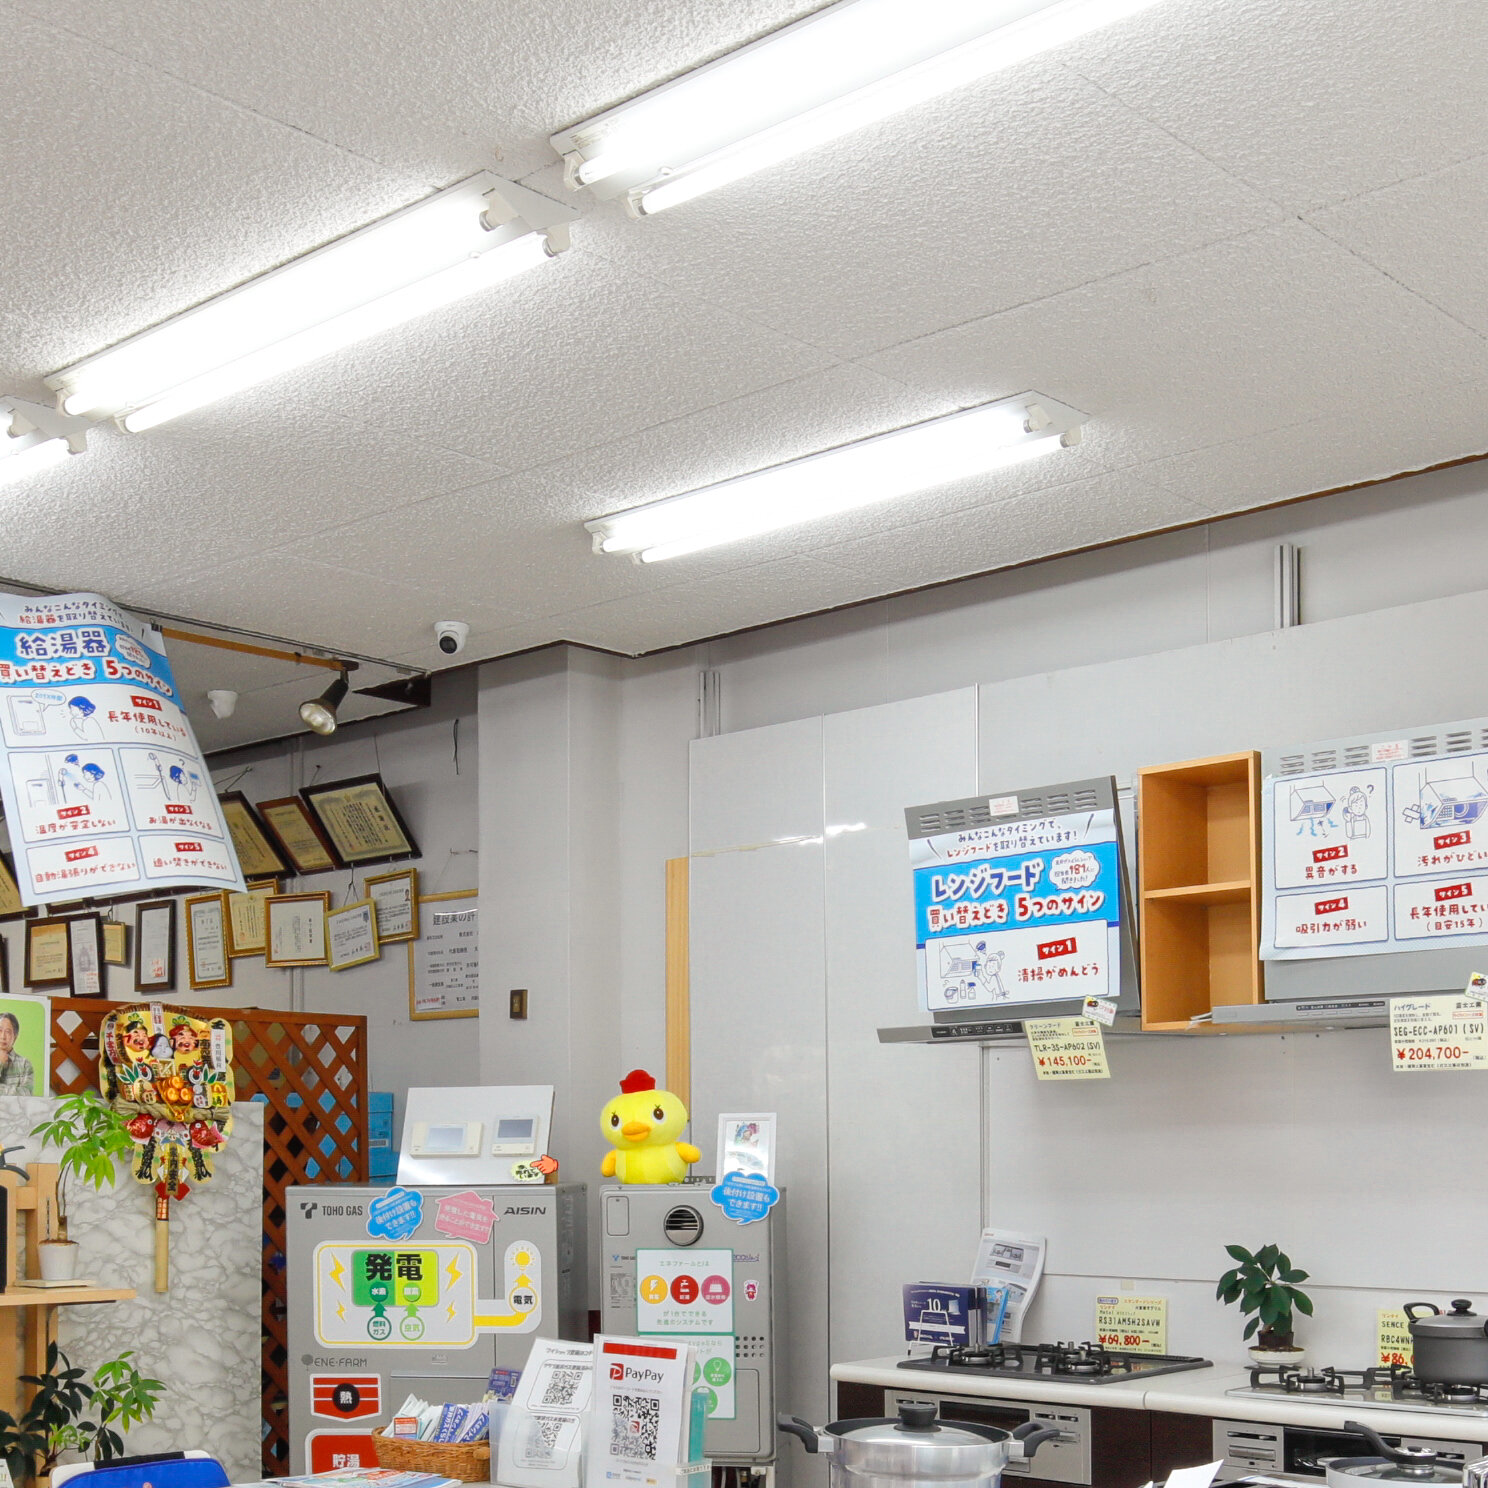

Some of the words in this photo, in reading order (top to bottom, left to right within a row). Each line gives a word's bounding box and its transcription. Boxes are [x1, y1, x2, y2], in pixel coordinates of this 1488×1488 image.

[19, 631, 107, 655] 給湯器
[106, 660, 172, 694] 5つのサイン
[36, 819, 116, 834] 温度が安定しない
[958, 820, 1062, 842] みんなこんなタイミングで、
[947, 831, 1077, 858] レンジフードを取り替えています!
[1417, 851, 1488, 866] 汚れがひどい
[935, 862, 1040, 897] レンジフード
[1306, 865, 1357, 879] 異音がする
[930, 904, 1005, 927] 買い替えどき
[1018, 894, 1101, 916] 5つのサイン
[1296, 919, 1367, 934] 吸引力が弱い
[1018, 964, 1100, 982] 清掃がめんどう
[1397, 1046, 1468, 1060] ¥204,700-
[322, 1206, 343, 1216] TOHO
[345, 1206, 363, 1216] GAS
[504, 1207, 546, 1215] AISIN
[366, 1254, 422, 1281] 発電
[513, 1295, 533, 1305] 電気
[626, 1366, 664, 1382] PayPay
[340, 1391, 352, 1404] 熱
[332, 1454, 360, 1467] 貯湯
